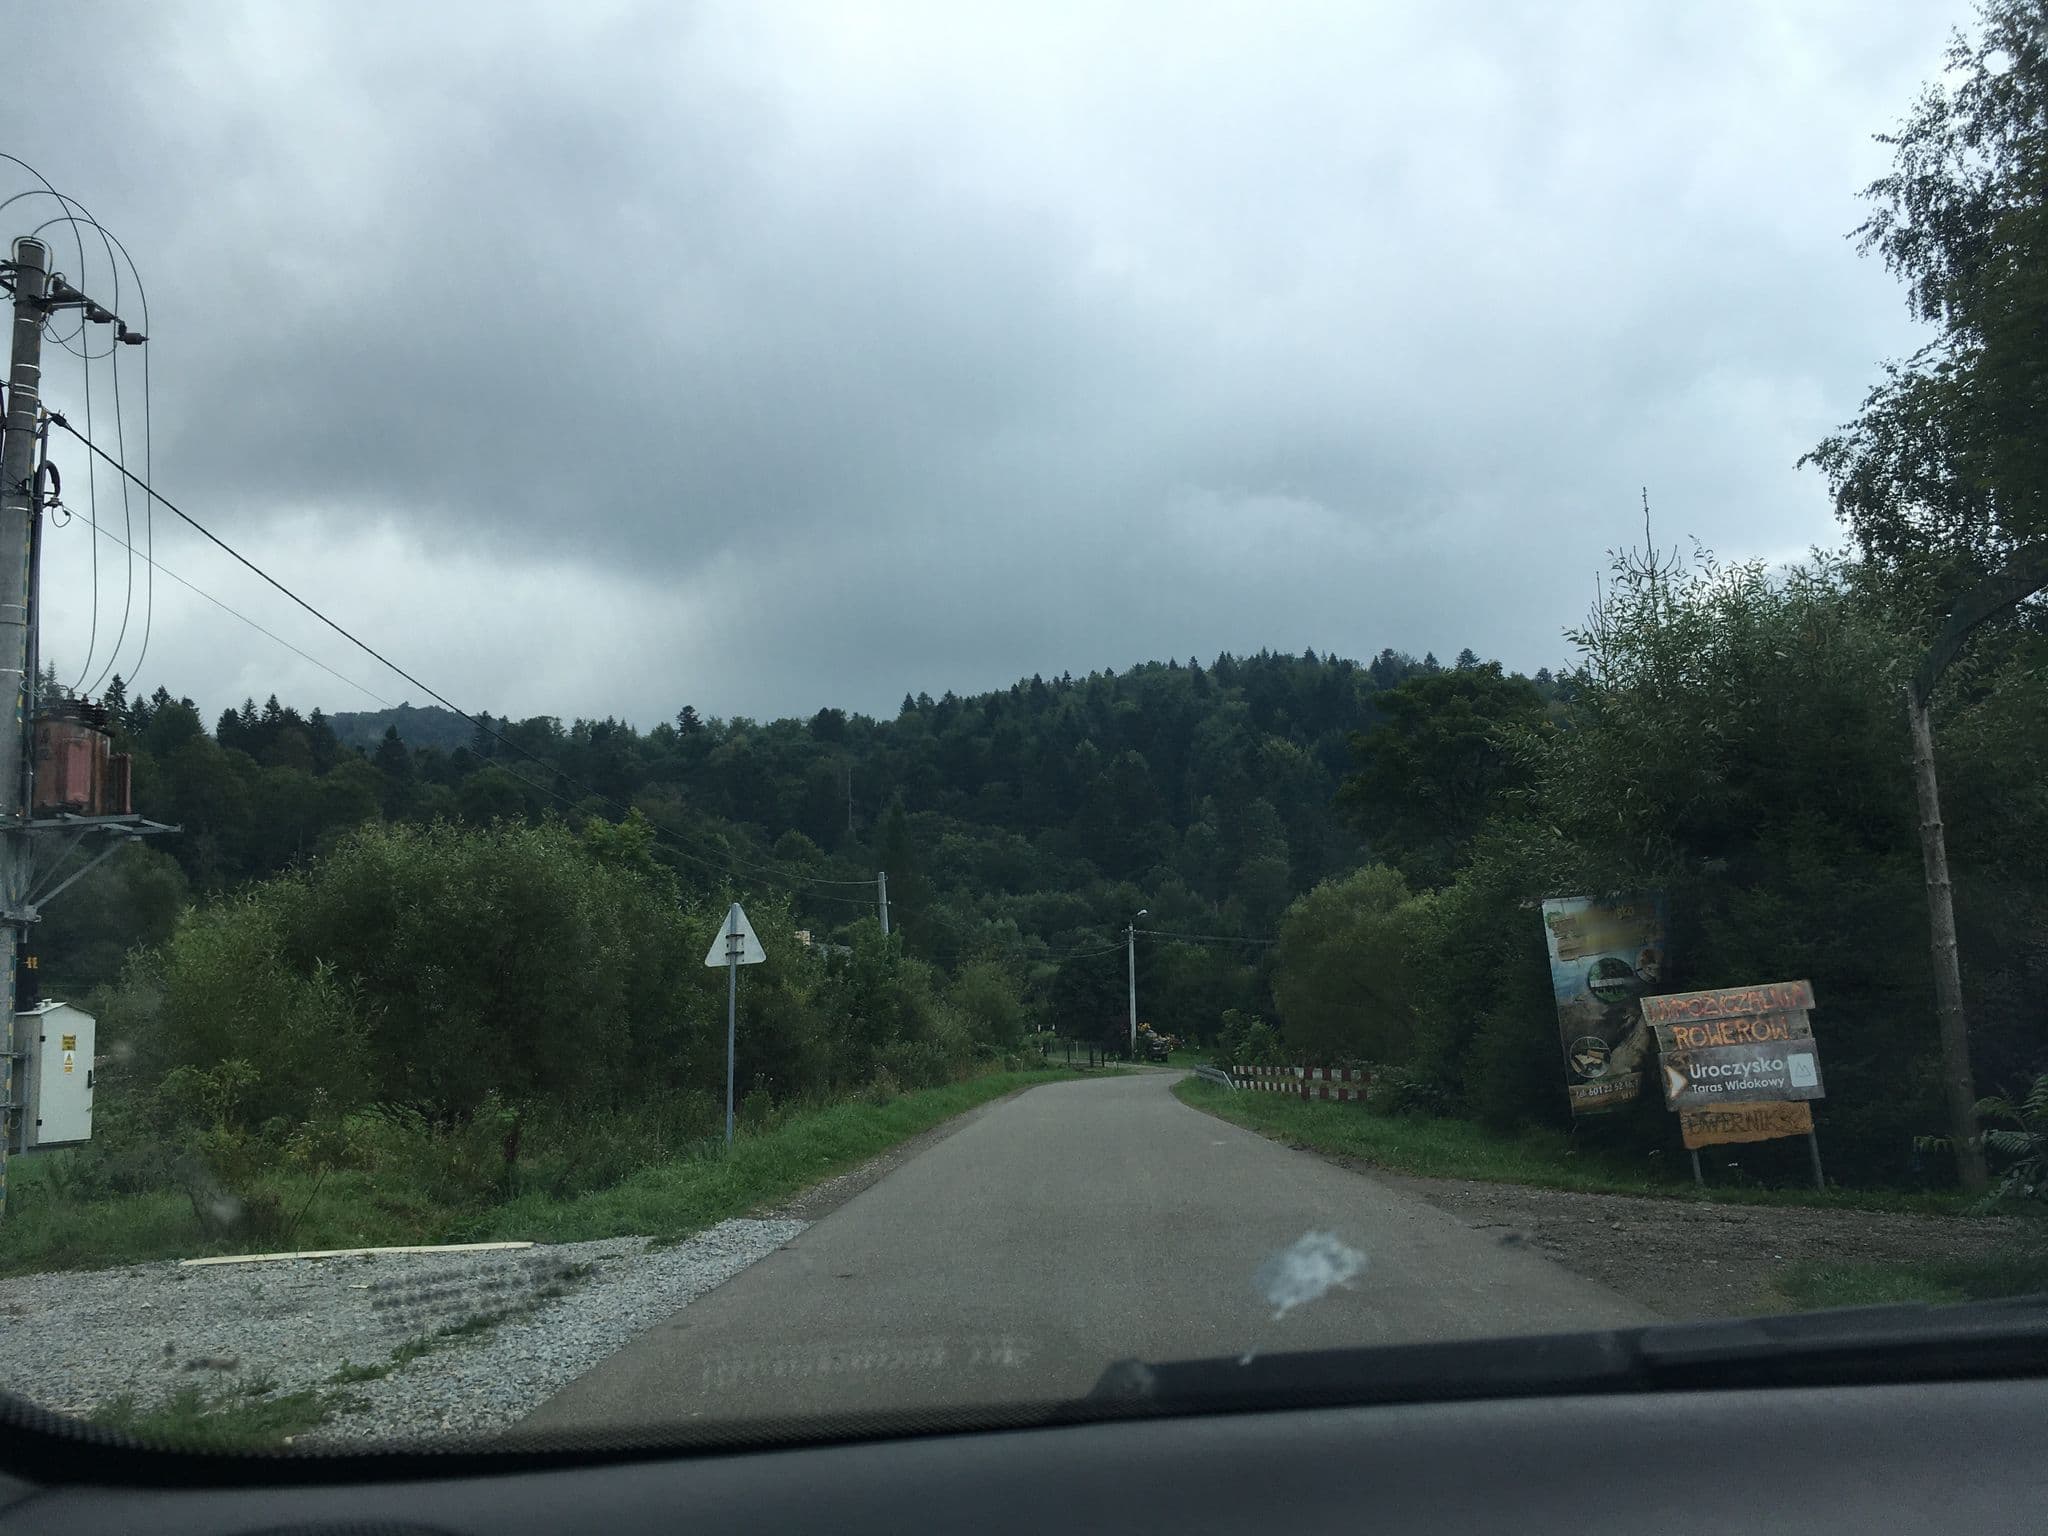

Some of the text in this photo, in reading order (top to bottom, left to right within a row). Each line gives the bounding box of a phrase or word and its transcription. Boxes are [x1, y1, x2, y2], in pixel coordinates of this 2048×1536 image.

[1690, 1057, 1783, 1078] Uroczysko
[1692, 1078, 1784, 1093] Taras Widokowy
